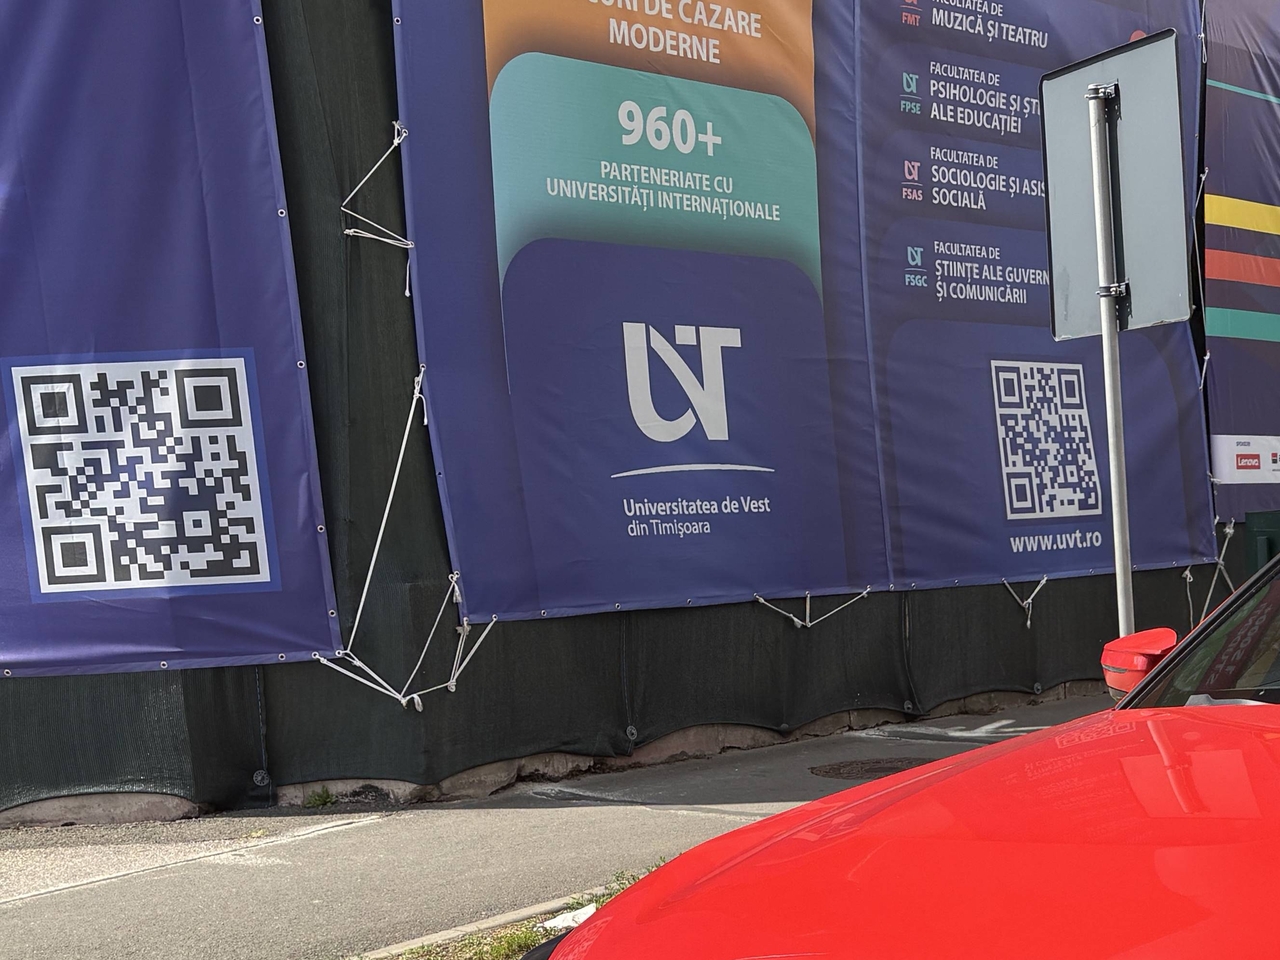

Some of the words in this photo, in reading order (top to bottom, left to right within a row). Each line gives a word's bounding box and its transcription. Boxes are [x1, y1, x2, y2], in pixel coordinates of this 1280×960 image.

[678, 0, 762, 38] CAZARE
[902, 12, 920, 26] FMT
[991, 3, 1003, 17] DE
[932, 8, 984, 35] MUZICĂ
[987, 20, 998, 42] ȘI
[1001, 23, 1048, 48] TEATRU
[609, 18, 721, 64] MODERNE
[930, 61, 985, 83] FACULTATEA
[988, 72, 1000, 86] DE
[900, 101, 921, 114] FPSE
[930, 80, 1007, 109] PSIHOLOGIE
[1009, 95, 1020, 115] ȘI
[617, 100, 722, 156] 960+
[930, 103, 955, 122] ALE
[957, 107, 1022, 135] EDUCAȚIEI
[930, 147, 985, 167] FACULTATEA
[987, 155, 998, 169] DE
[600, 160, 710, 192] PARTENERIATE
[714, 175, 733, 194] CU
[931, 165, 1007, 191] SOCIOLOGIE
[1009, 177, 1019, 198] ȘI
[546, 177, 654, 212] UNIVERSITĂȚI
[658, 192, 780, 221] INTERNAȚIONALE
[902, 188, 923, 201] FSAS
[932, 187, 986, 210] SOCIALĂ
[934, 241, 987, 258] FACULTATEA
[989, 247, 1000, 260] DE
[905, 274, 928, 287] FSGC
[935, 260, 979, 282] ȘTIINȚE
[982, 264, 1003, 281] ALE
[936, 281, 947, 302] ȘI
[950, 283, 1027, 304] COMUNICĂRII
[623, 498, 719, 517] Universitatea
[722, 498, 739, 515] de
[741, 497, 770, 514] Vest
[628, 520, 648, 537] din
[651, 519, 711, 539] Timișoara
[1010, 528, 1103, 554] www.uvt.ro
